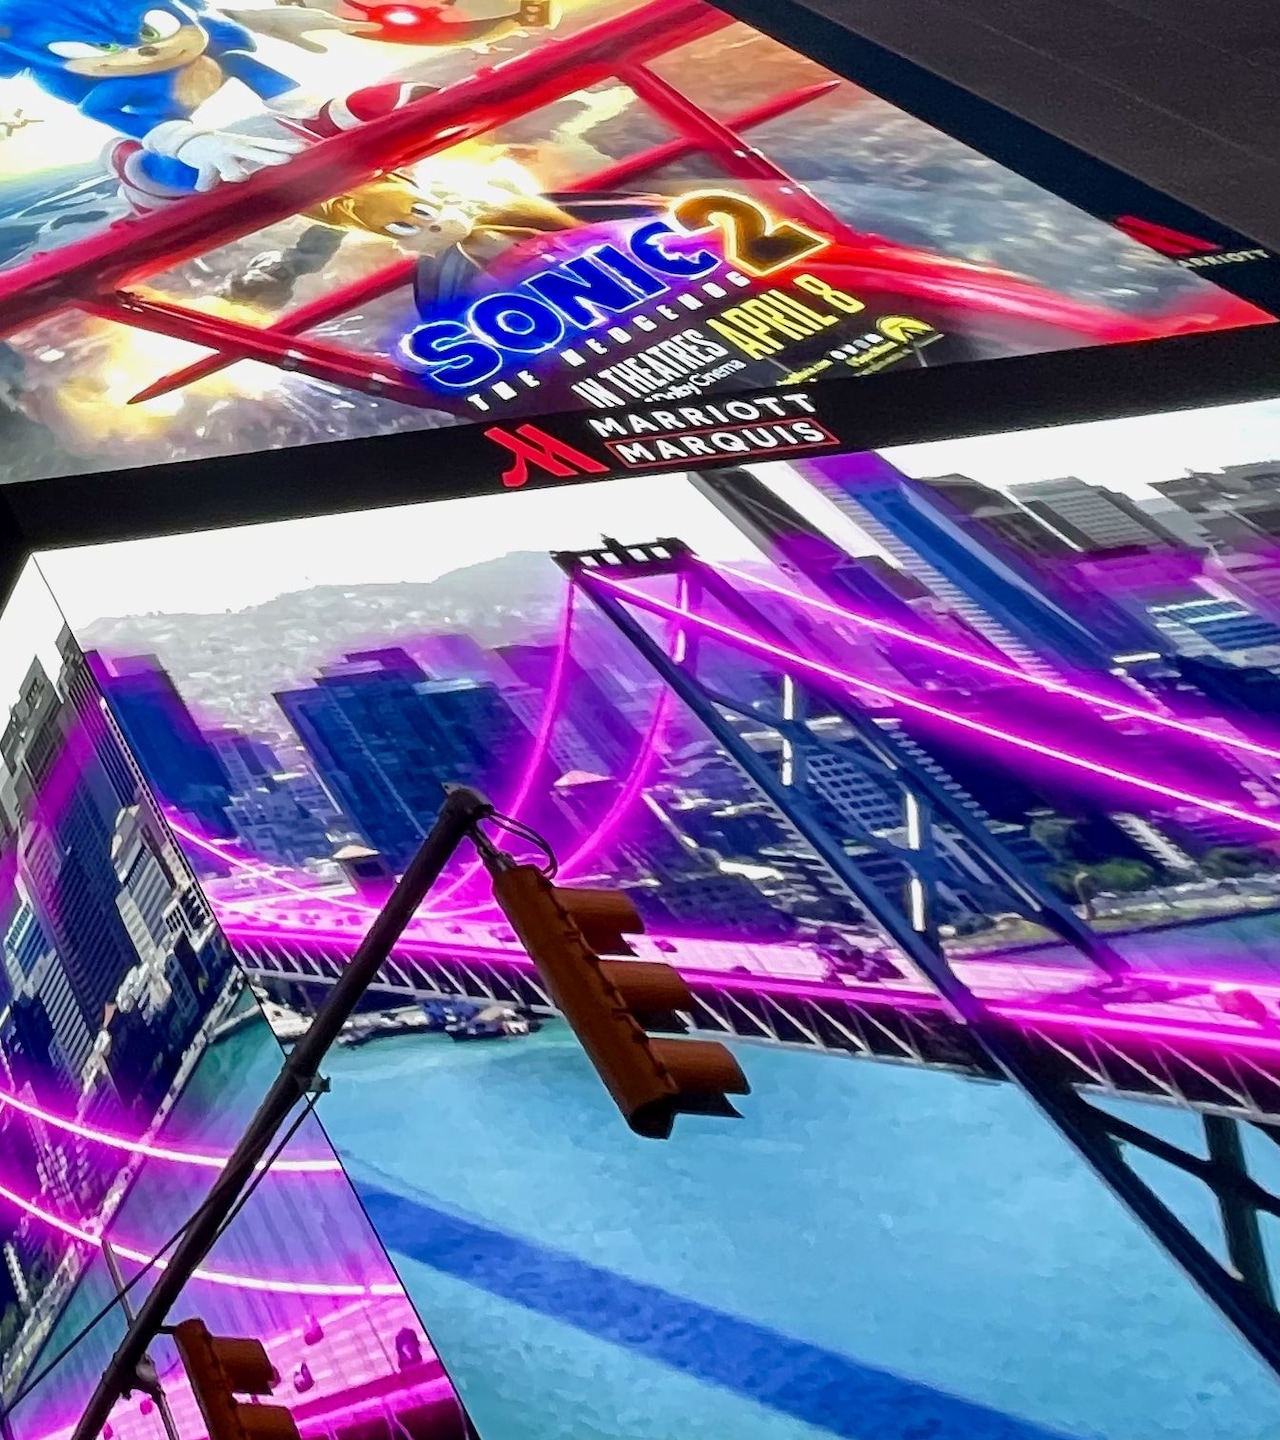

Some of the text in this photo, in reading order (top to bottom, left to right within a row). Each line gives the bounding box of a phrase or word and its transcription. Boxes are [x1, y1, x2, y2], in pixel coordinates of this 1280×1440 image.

[1178, 249, 1270, 268] ARRIOTT
[399, 221, 723, 388] SONIC
[668, 190, 831, 276] 2
[792, 274, 867, 315] 8
[467, 369, 541, 412] THE
[561, 271, 751, 367] HEDGEHOG
[706, 289, 839, 360] APRIL
[597, 329, 729, 398] THEATRES
[689, 359, 747, 387] Cinema
[571, 378, 626, 408] IN
[589, 394, 817, 438] MARRIOTT
[615, 422, 826, 464] MARQUIS
